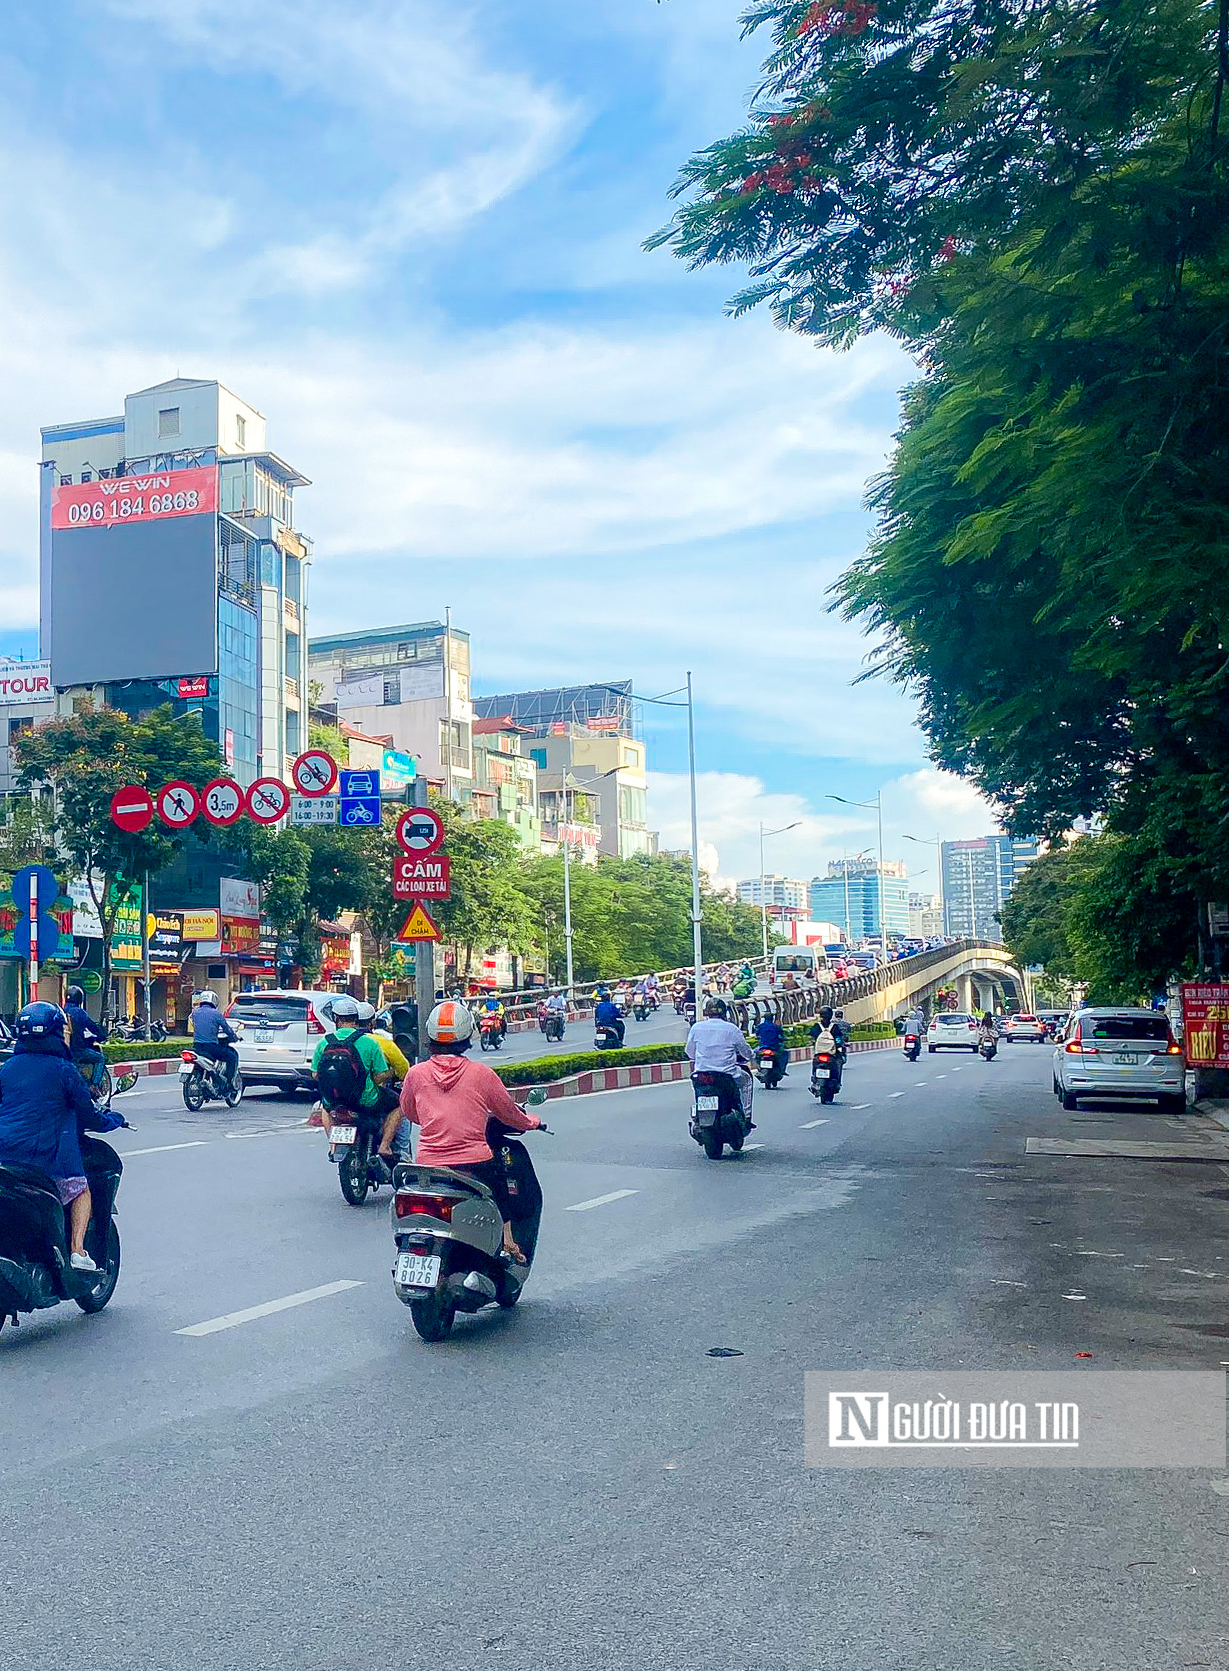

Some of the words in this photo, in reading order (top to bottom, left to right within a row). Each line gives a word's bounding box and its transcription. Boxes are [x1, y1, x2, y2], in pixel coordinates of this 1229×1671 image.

[100, 482, 131, 496] WE
[133, 476, 170, 491] WIN
[68, 501, 104, 523] 096
[109, 496, 144, 519] 184
[149, 490, 198, 514] 6868
[210, 793, 235, 812] 3,5m
[401, 857, 442, 878] CẤM
[396, 879, 409, 892] CÁC
[410, 880, 426, 893] LOẠI
[426, 881, 435, 892] XE
[435, 879, 447, 892] TẢI
[402, 1256, 434, 1271] 30-K4
[401, 1270, 432, 1285] 8026
